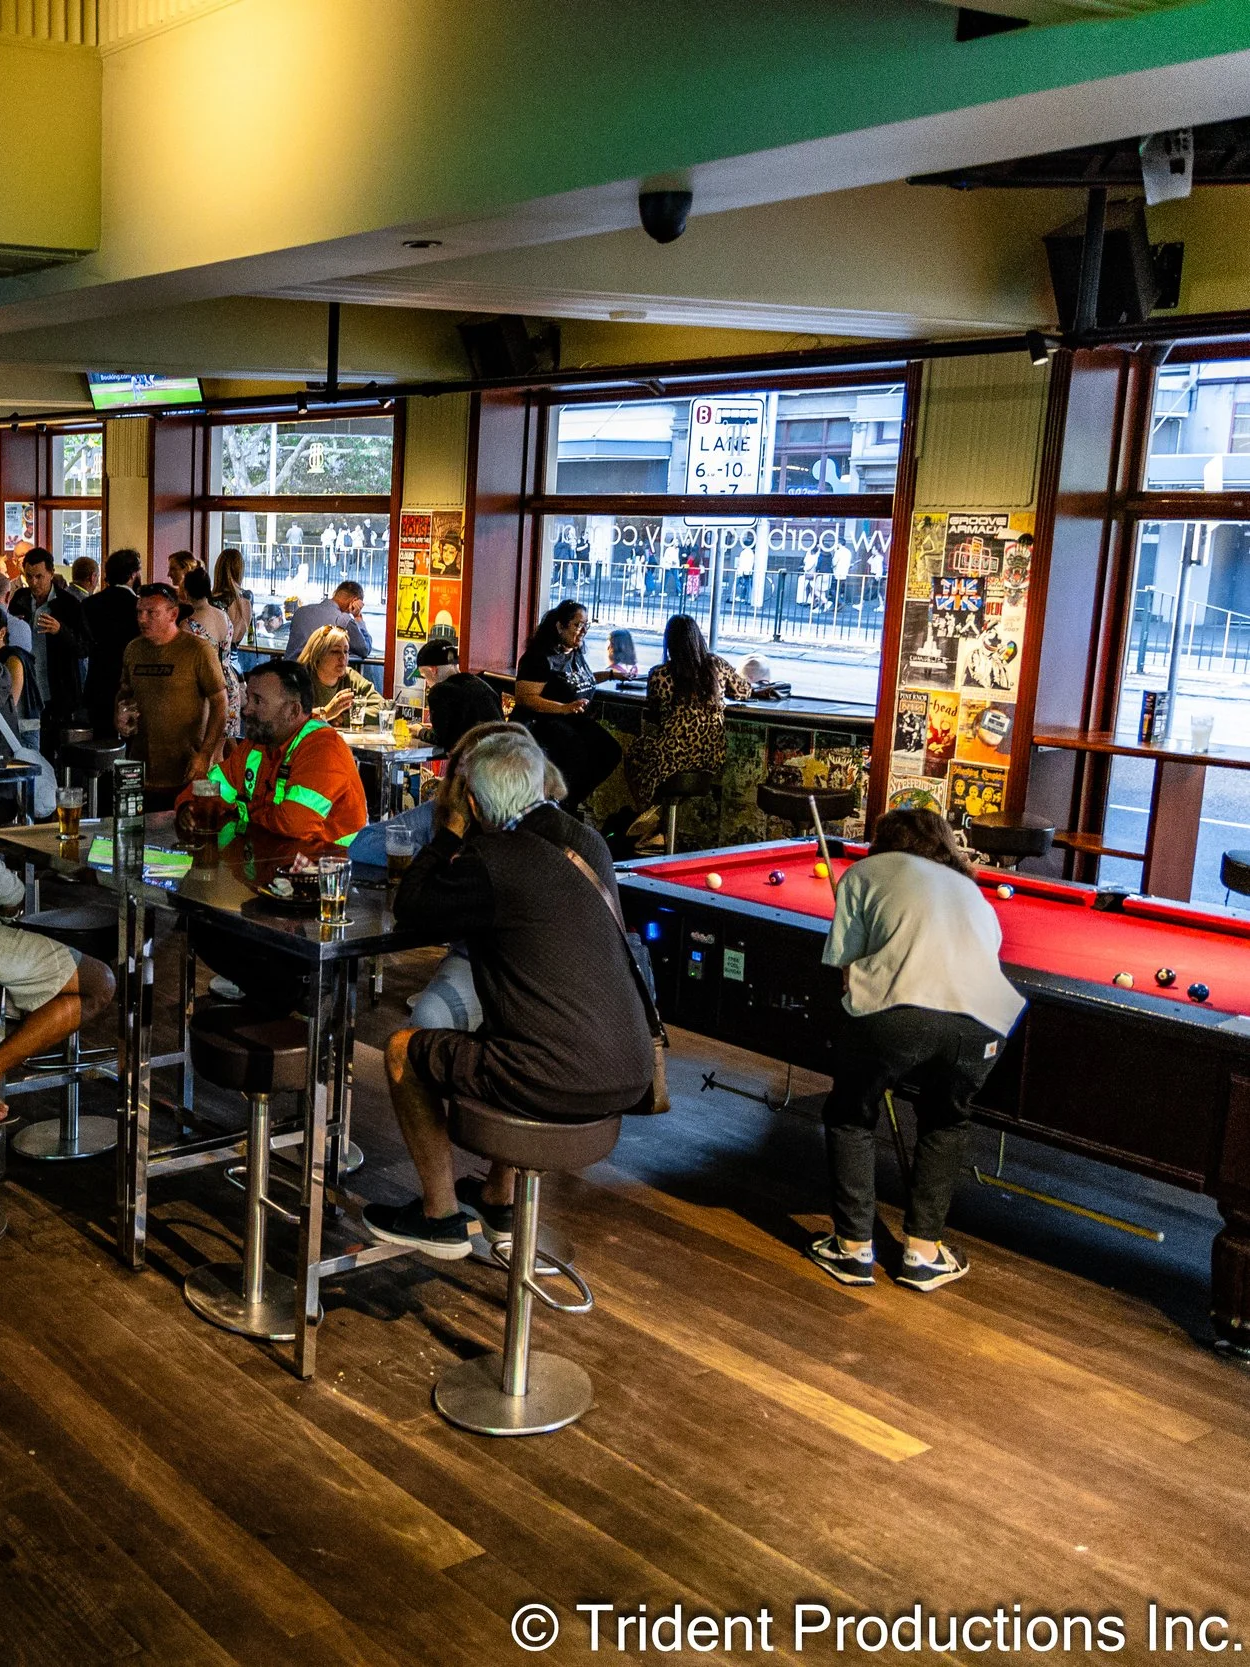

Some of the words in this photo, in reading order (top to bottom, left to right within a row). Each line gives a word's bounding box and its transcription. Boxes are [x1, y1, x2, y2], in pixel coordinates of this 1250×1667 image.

[700, 436, 751, 452] LANE
[949, 516, 1008, 525] GROOVE
[940, 578, 978, 595] THE
[935, 595, 983, 611] WHO
